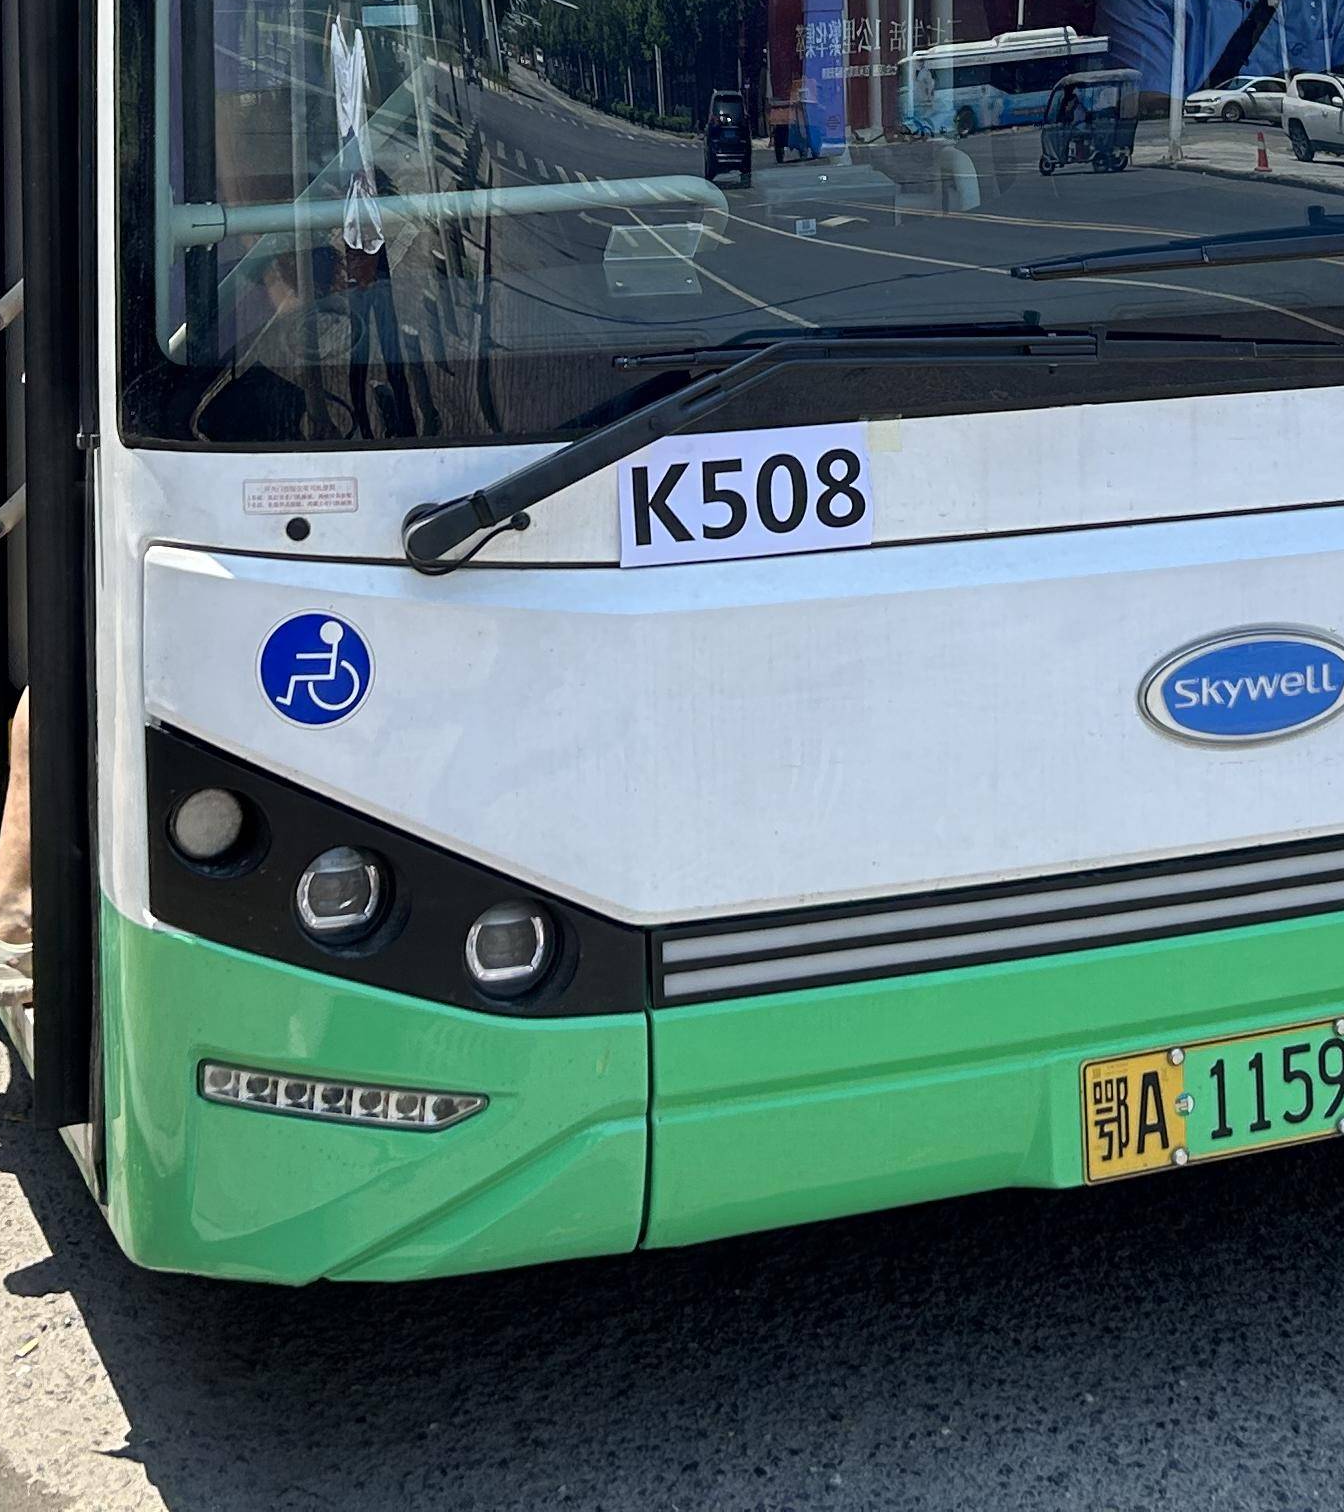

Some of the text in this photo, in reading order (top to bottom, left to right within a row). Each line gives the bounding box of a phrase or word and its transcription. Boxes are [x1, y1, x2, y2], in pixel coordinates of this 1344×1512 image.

[631, 447, 868, 548] K508
[1174, 660, 1338, 710] Skywell
[1092, 1070, 1169, 1162] 鄂A
